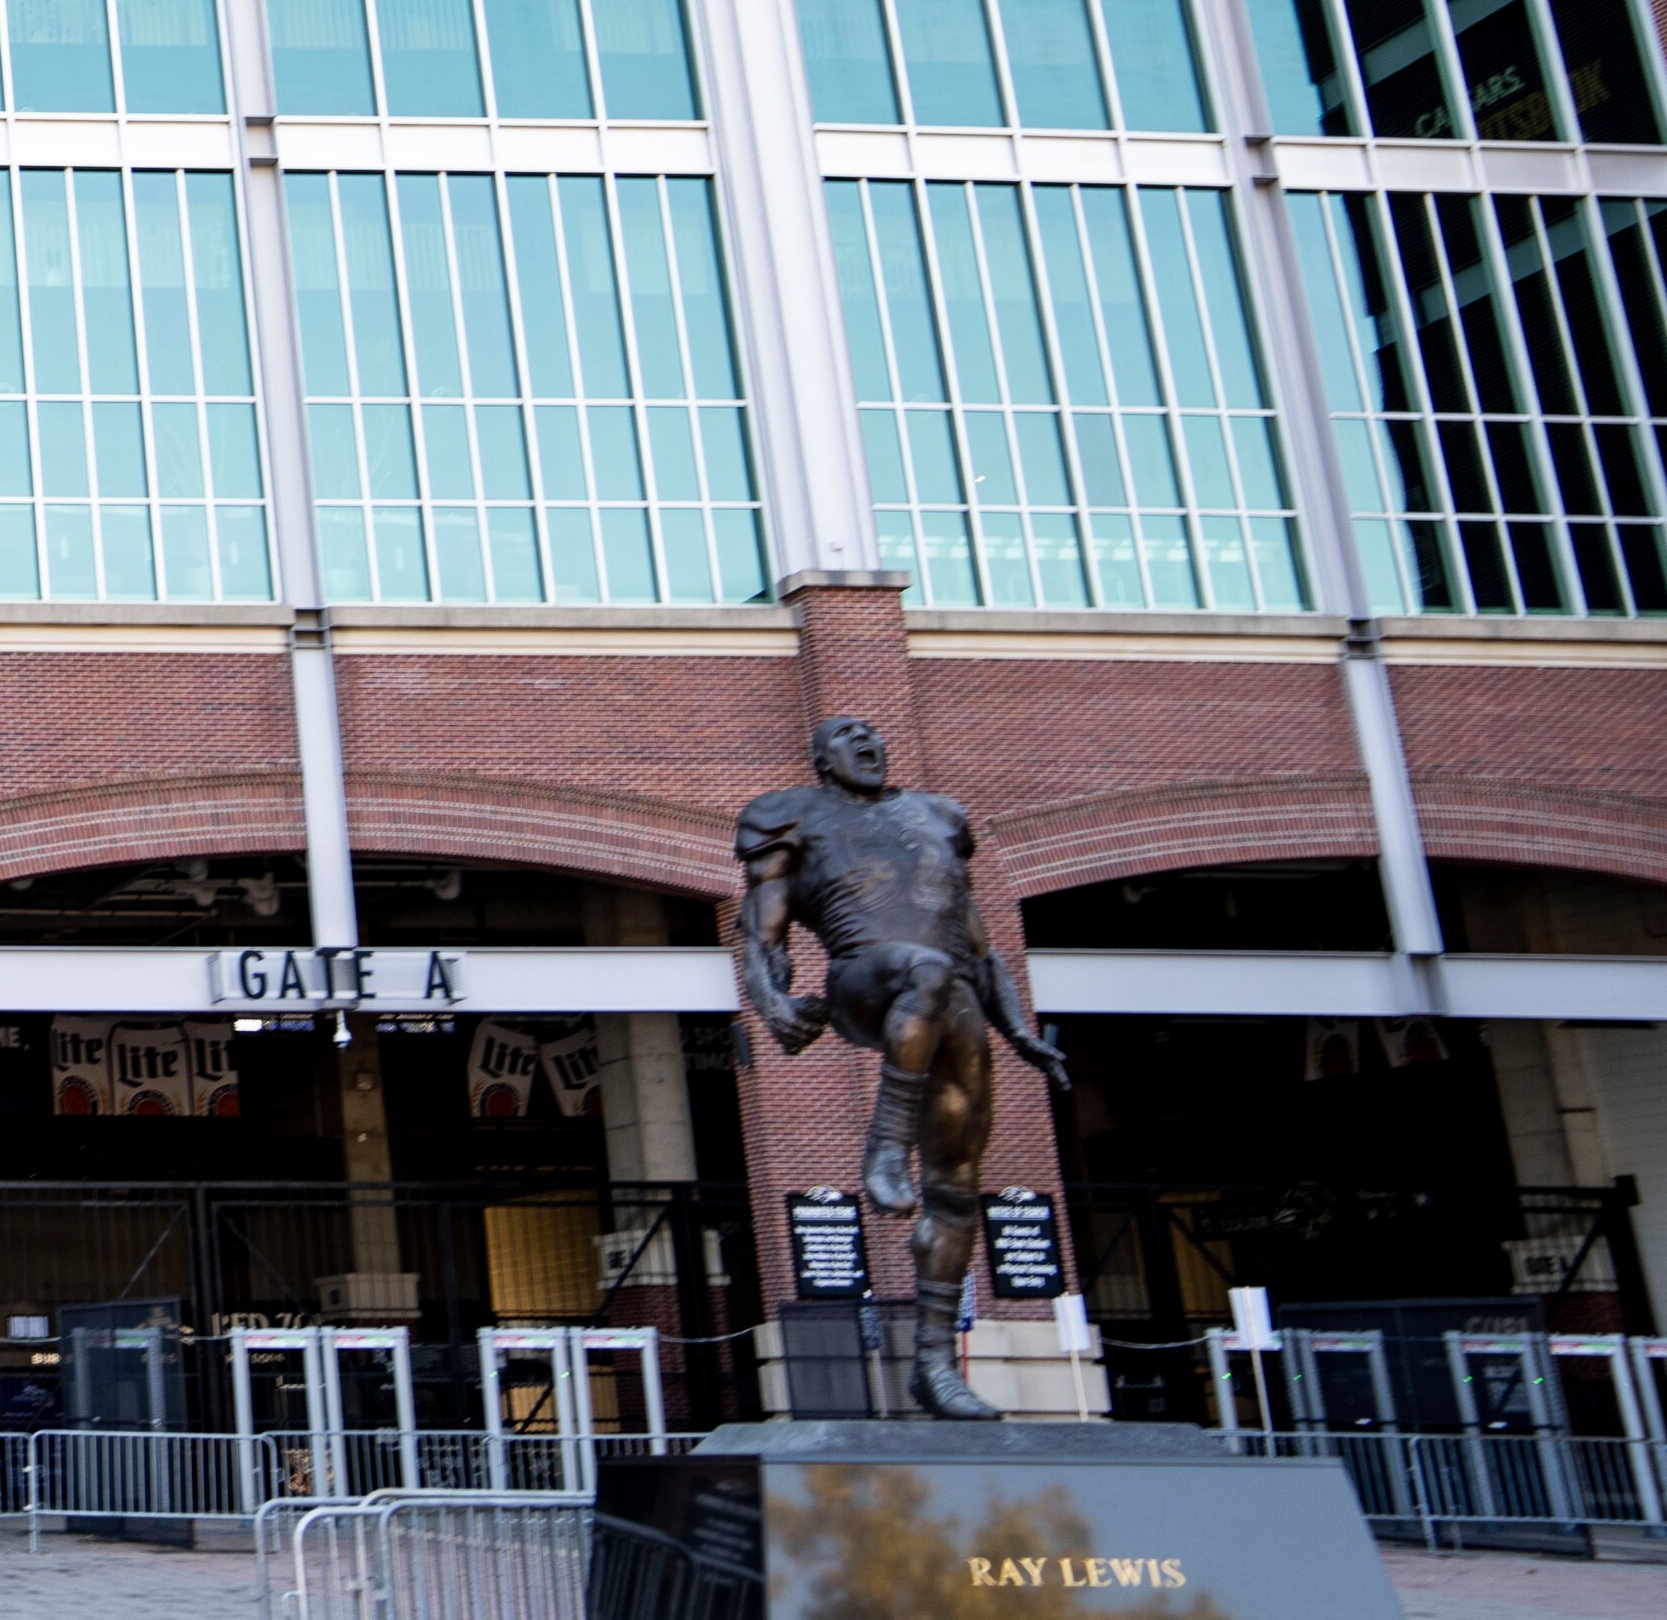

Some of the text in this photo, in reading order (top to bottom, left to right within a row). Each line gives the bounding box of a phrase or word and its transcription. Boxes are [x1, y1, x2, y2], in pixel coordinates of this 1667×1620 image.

[239, 948, 453, 1000] GATE A
[119, 1036, 240, 1087] Lite Lit
[479, 1036, 538, 1078] Lite
[551, 1043, 599, 1090] Lit
[966, 1556, 1188, 1589] RAY LEWIS
